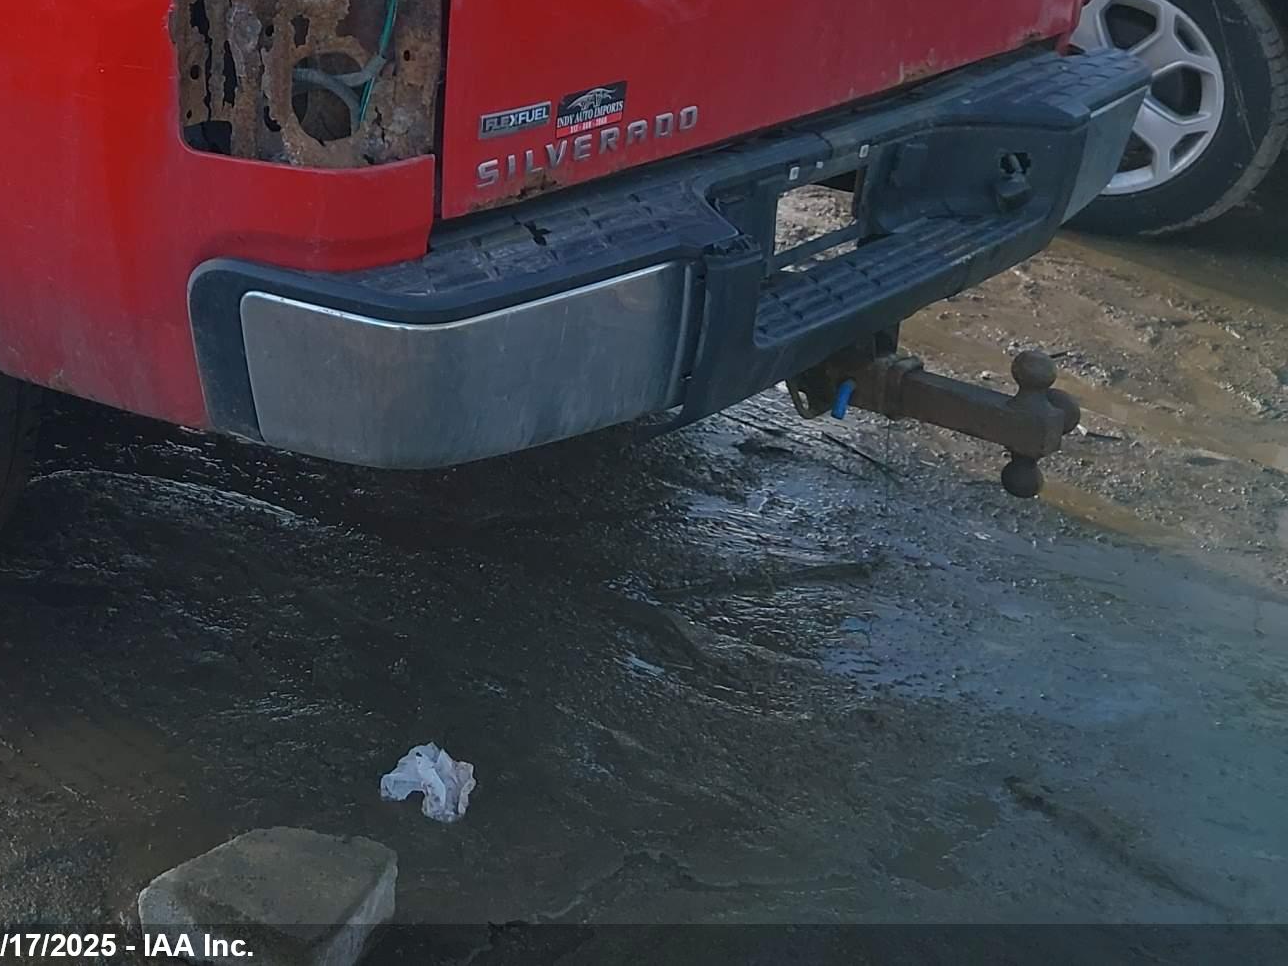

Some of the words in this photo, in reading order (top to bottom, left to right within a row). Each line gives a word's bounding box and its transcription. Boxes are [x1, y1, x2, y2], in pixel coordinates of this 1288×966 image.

[485, 106, 550, 131] FLEXFUEL
[556, 114, 575, 128] INDY
[574, 109, 594, 124] AUTO
[594, 100, 624, 118] IMPORTS
[477, 105, 698, 187] SILVERADO
